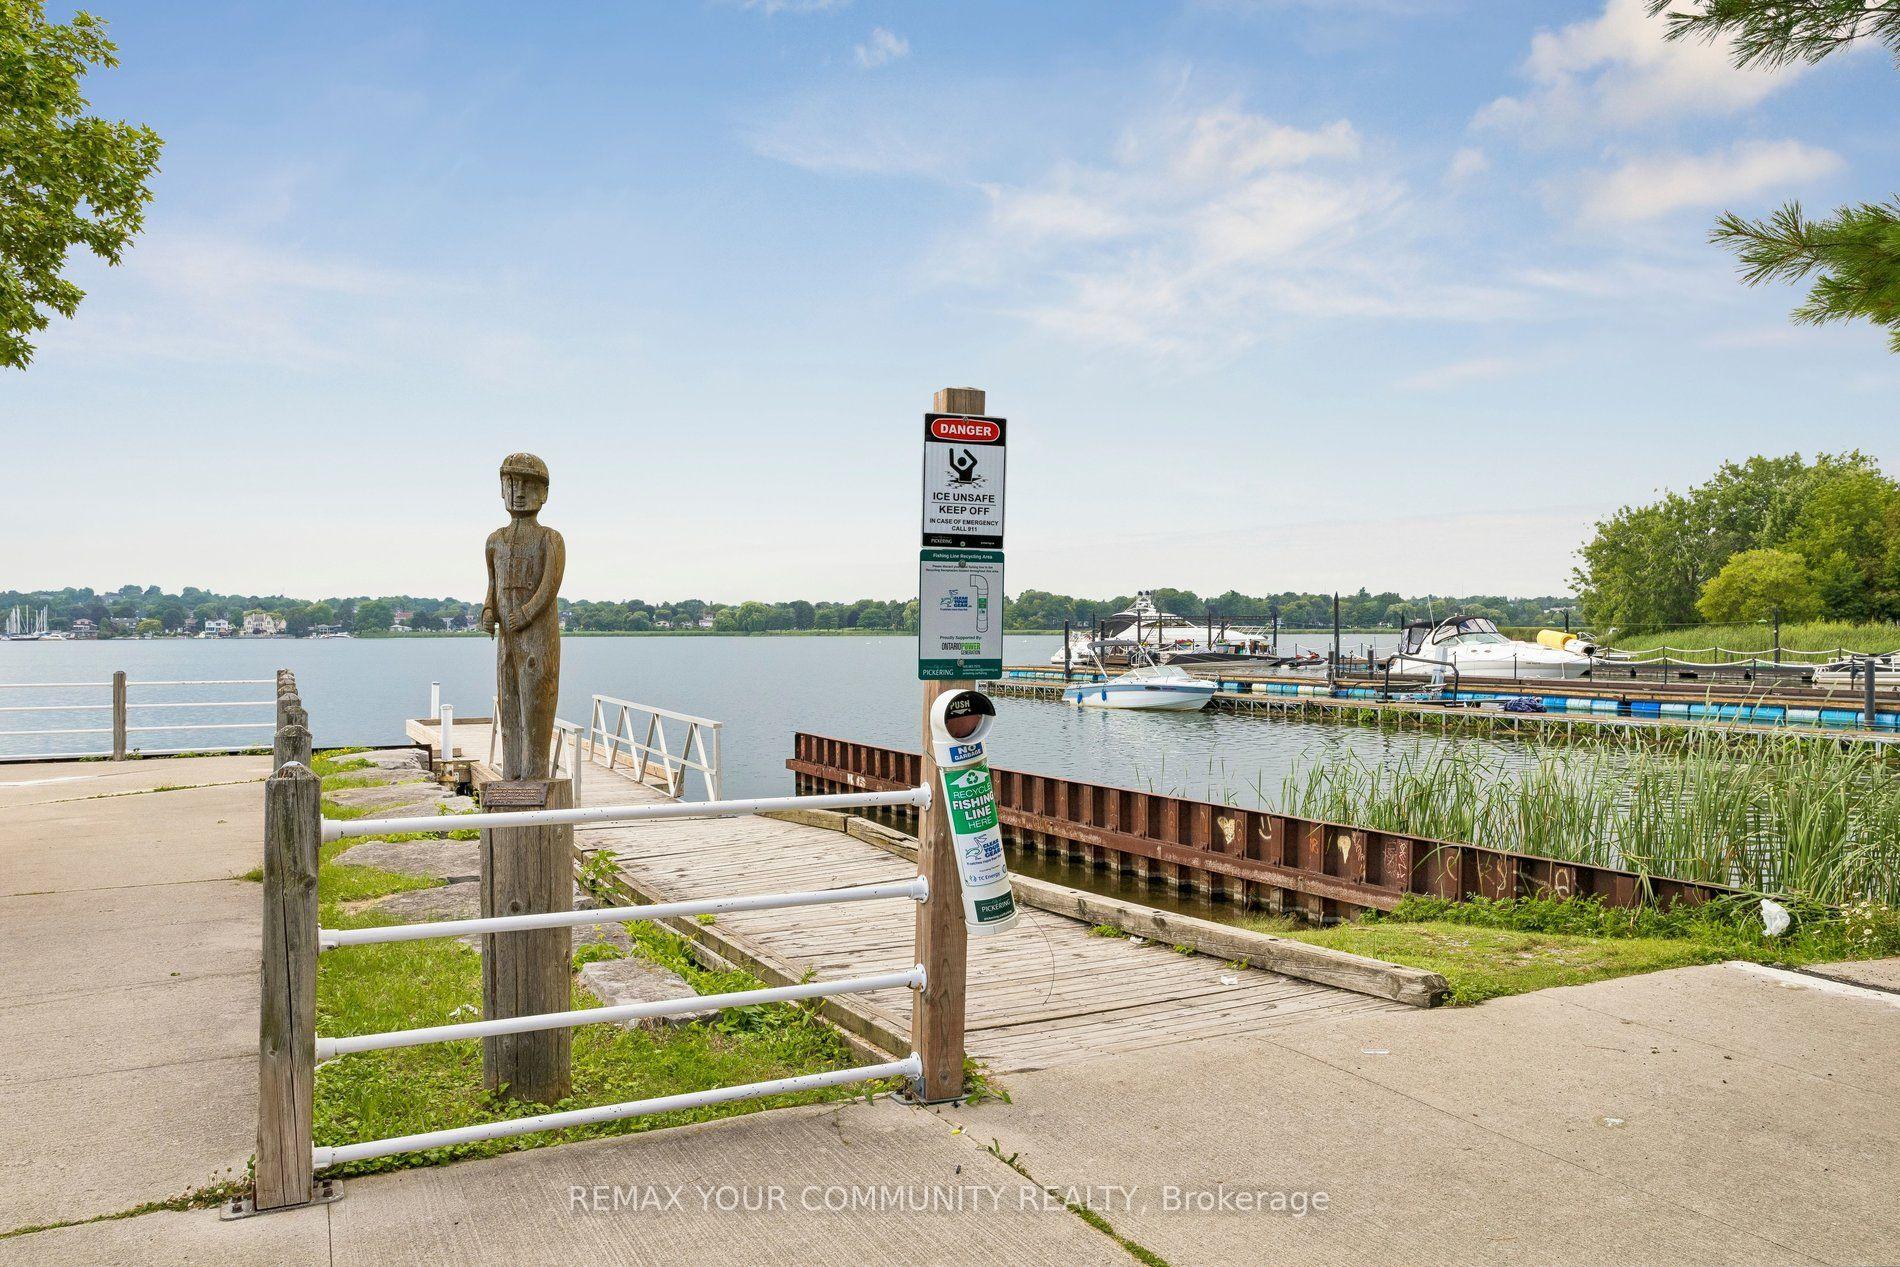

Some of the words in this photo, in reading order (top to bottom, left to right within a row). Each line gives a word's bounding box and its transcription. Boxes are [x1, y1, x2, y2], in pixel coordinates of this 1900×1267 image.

[940, 423, 992, 437] DANGER
[932, 492, 951, 501] ICE
[953, 493, 995, 503] UNSAFE
[939, 505, 967, 515] KEEP
[969, 507, 990, 516] OFF
[949, 700, 971, 710] PUSH
[954, 748, 982, 761] GARBAGE
[957, 744, 977, 755] NO
[953, 782, 991, 799] RECYCLE
[952, 790, 995, 810] FISHING
[964, 804, 992, 821] LINE
[968, 815, 993, 829] HERE
[981, 898, 1011, 912] PICKERING
